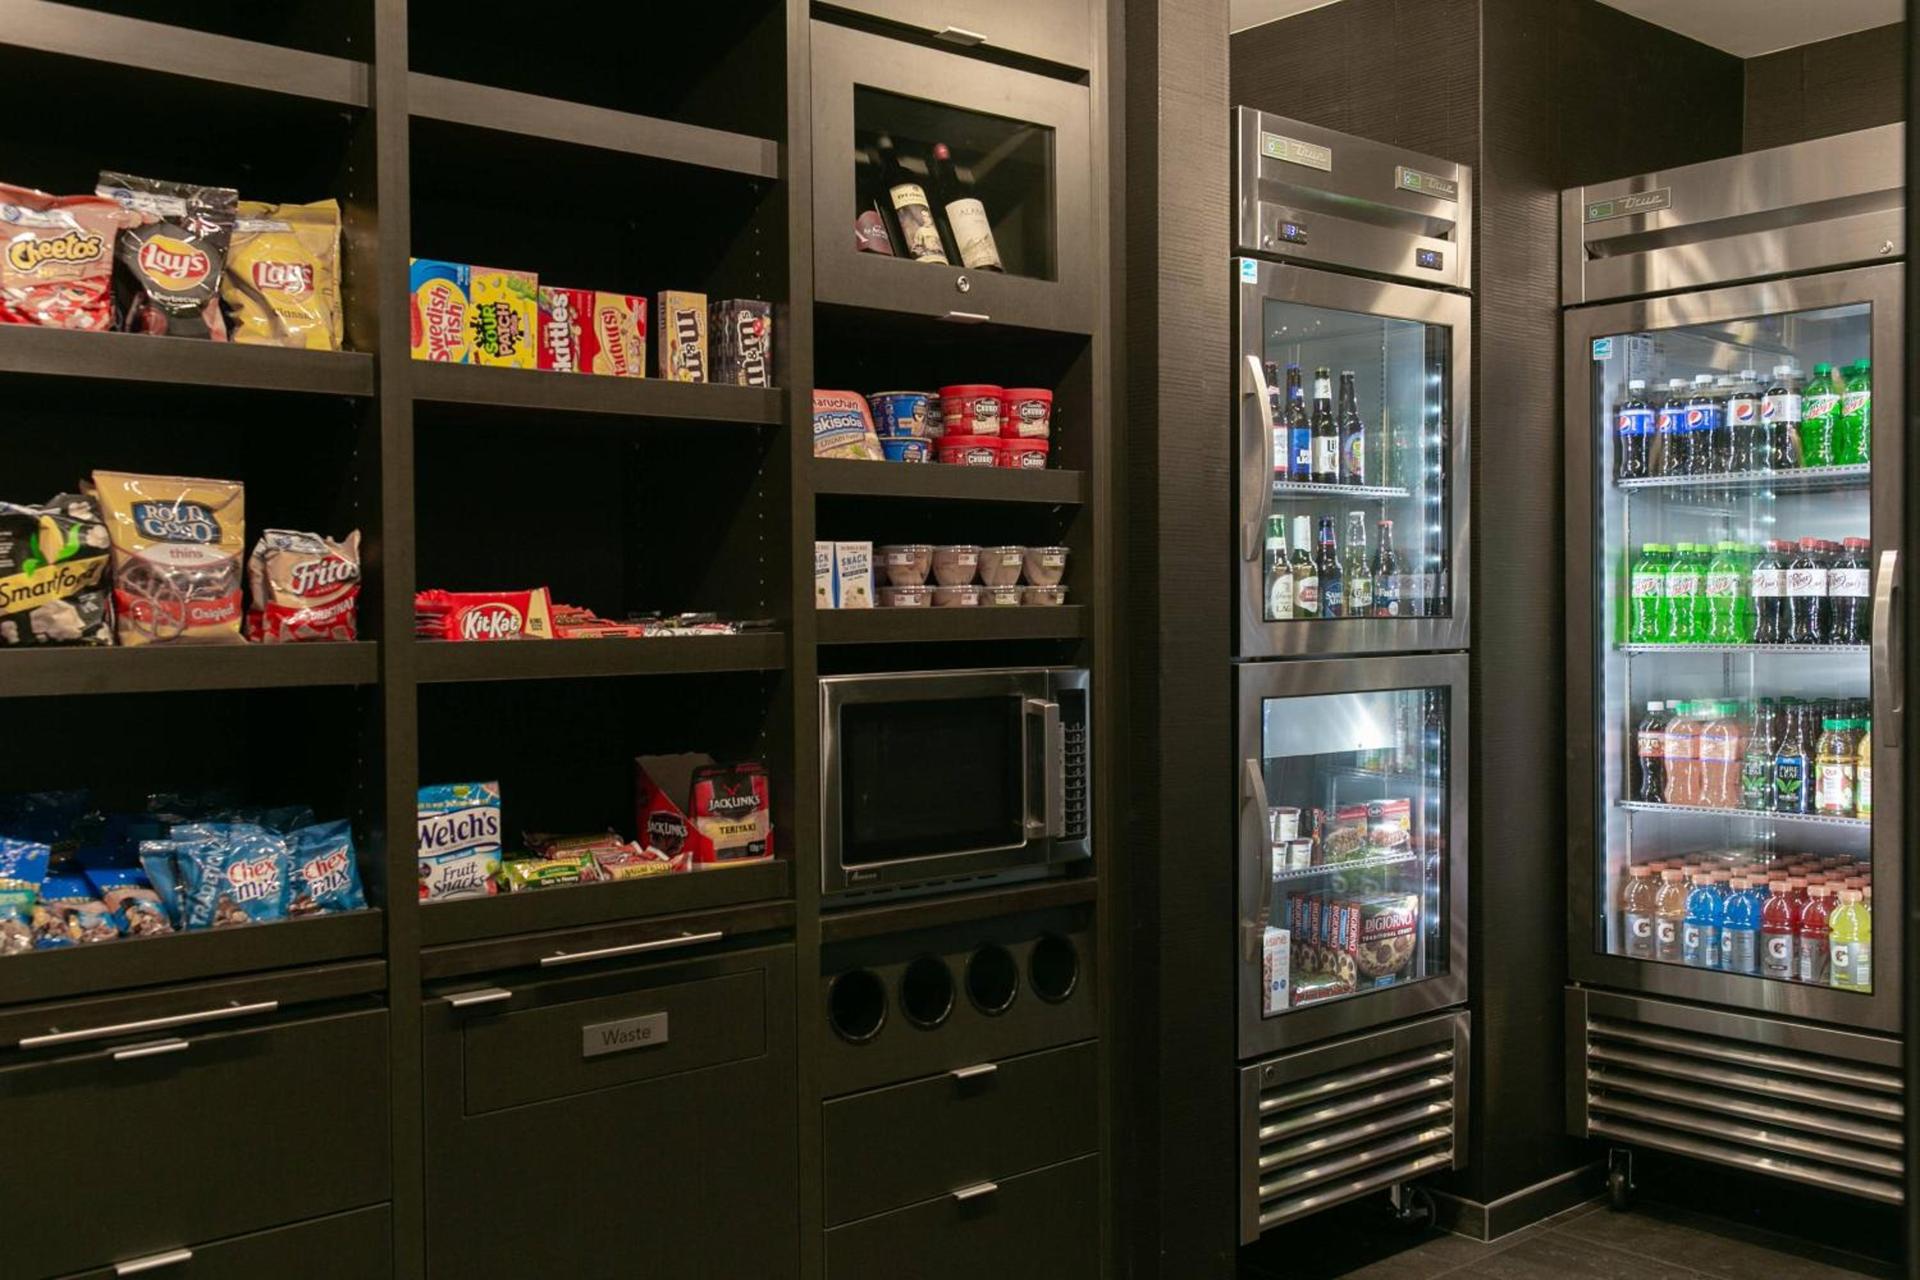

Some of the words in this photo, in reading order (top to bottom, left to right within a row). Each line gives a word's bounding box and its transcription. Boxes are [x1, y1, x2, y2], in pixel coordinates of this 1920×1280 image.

[9, 231, 101, 271] Cheetos
[143, 243, 206, 279] Lay's
[426, 286, 451, 361] Swedish
[445, 303, 464, 348] Fish
[481, 304, 498, 354] SOUR
[496, 302, 516, 357] PATCH
[548, 293, 572, 372] kittles
[601, 309, 628, 377] tarburst
[144, 504, 213, 528] ROLD
[169, 547, 204, 560] thins
[842, 553, 868, 566] SNACK
[291, 558, 360, 595] Fritos
[464, 611, 519, 640] KitKat
[417, 811, 498, 850] Welch's
[719, 823, 757, 835] TERIYAKI
[229, 858, 277, 883] Chex
[303, 851, 348, 880] Chex
[443, 861, 478, 882] Fruit
[237, 874, 277, 900] mix
[312, 869, 349, 896] mix
[432, 874, 485, 898] Snacks
[1348, 908, 1358, 951] DIGIORNO
[1364, 912, 1412, 931] DIGIORNO
[1633, 918, 1651, 937] G
[1657, 922, 1675, 943] G
[1685, 928, 1699, 948] G
[1721, 931, 1732, 952] G
[1768, 938, 1787, 959] G
[1831, 945, 1848, 967] G
[601, 1027, 652, 1046] Waste
